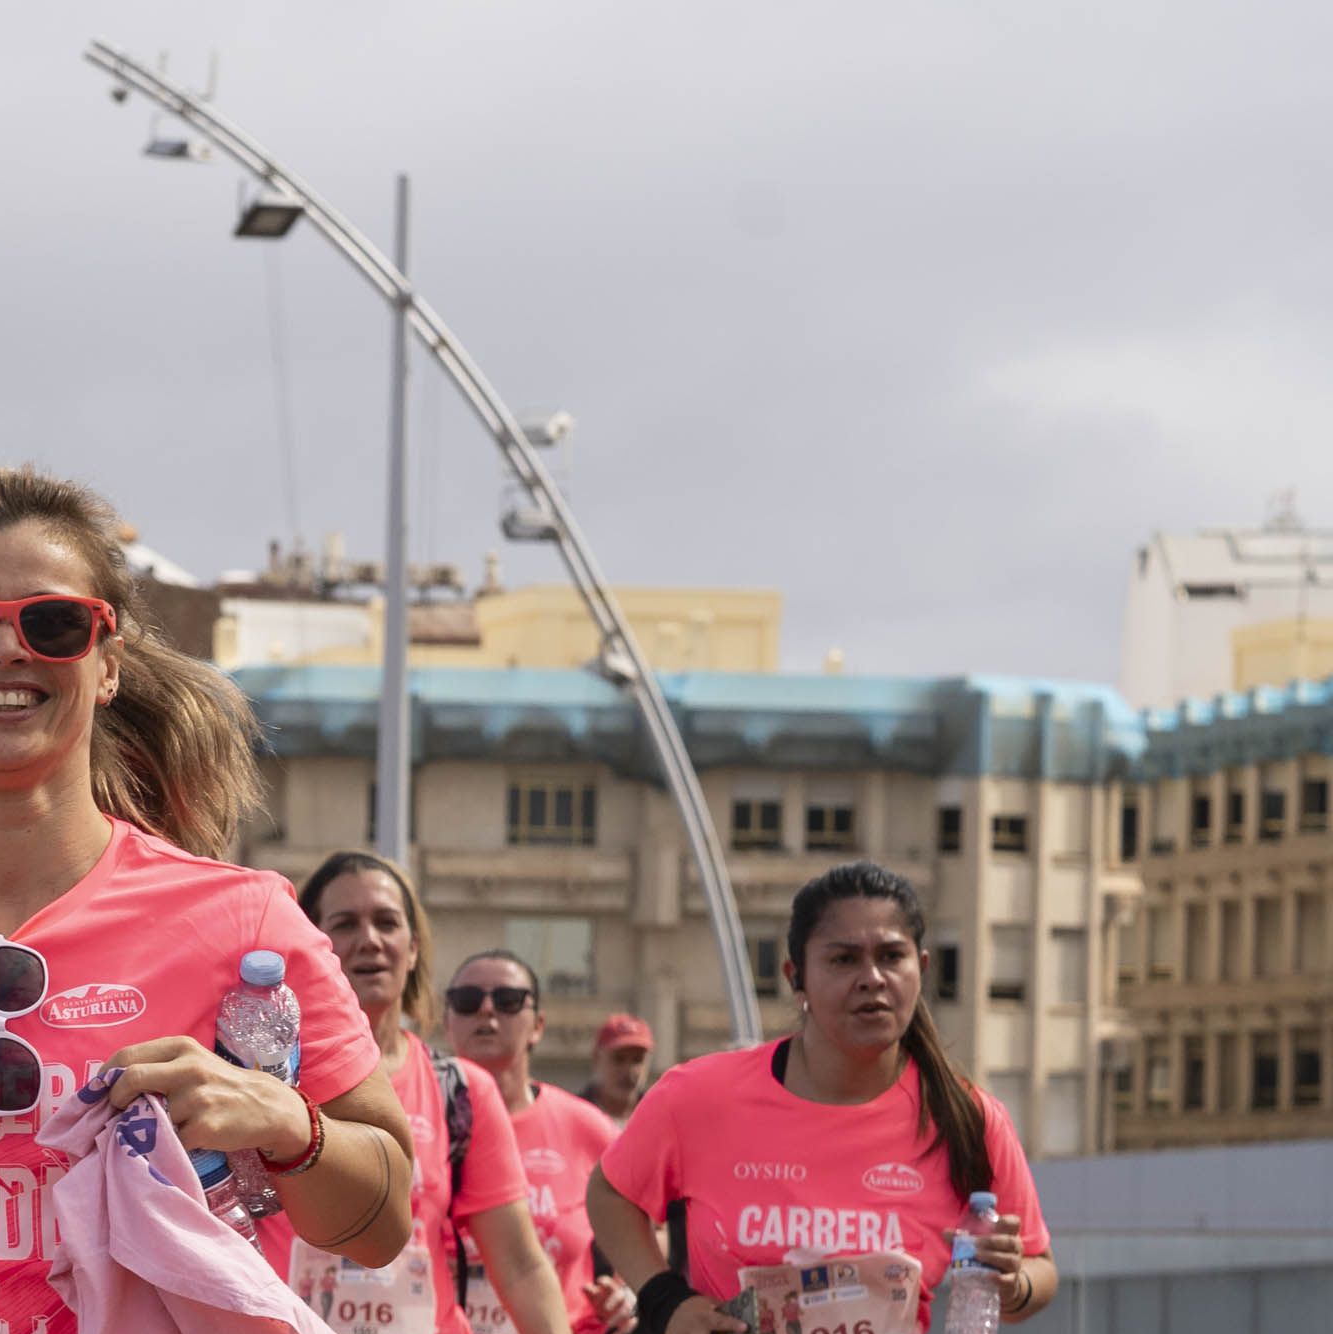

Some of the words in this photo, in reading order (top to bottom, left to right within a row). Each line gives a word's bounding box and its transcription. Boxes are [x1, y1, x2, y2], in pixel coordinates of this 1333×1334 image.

[47, 999, 139, 1021] ASTURIANA
[733, 1161, 807, 1182] OYSHO
[738, 1205, 907, 1253] CARRERA
[338, 1300, 393, 1325] 016
